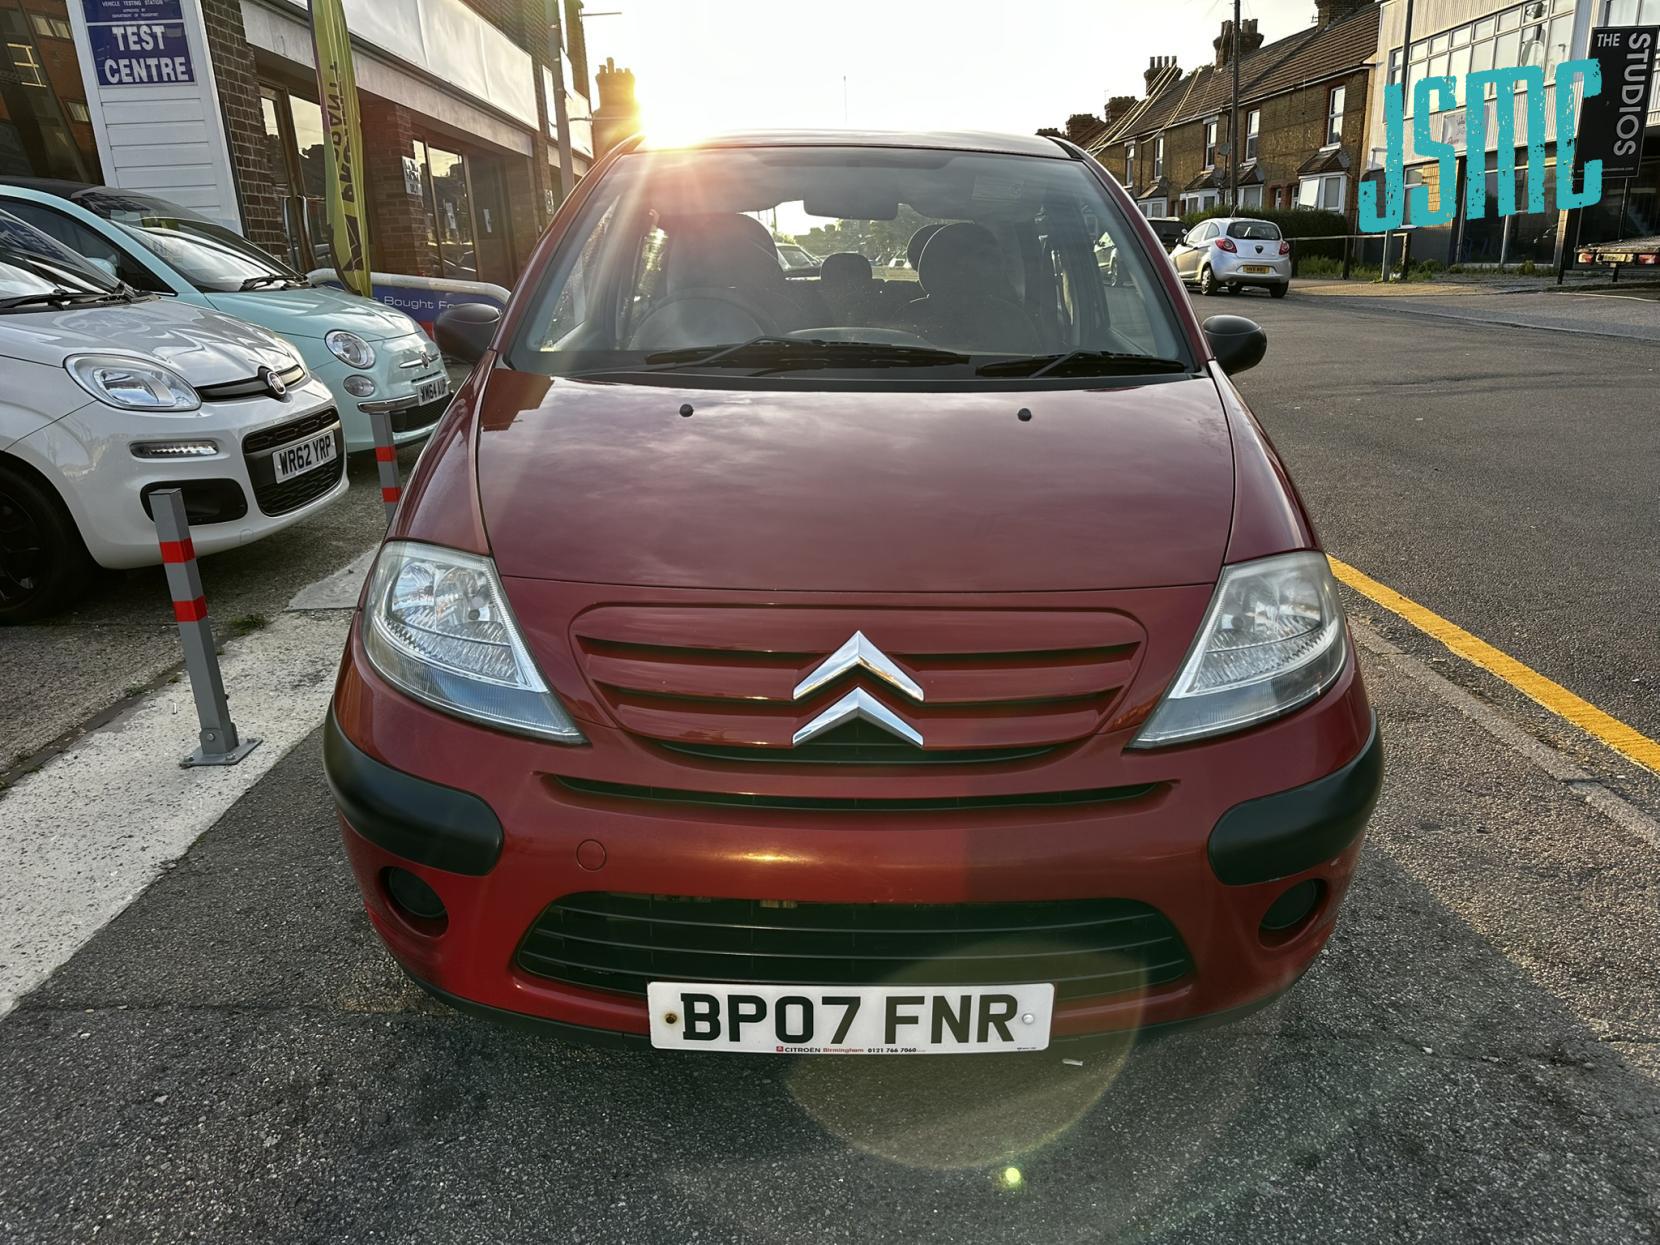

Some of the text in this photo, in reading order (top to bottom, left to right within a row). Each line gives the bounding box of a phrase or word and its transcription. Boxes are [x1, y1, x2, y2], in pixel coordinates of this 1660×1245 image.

[111, 25, 165, 51] TEST
[1597, 33, 1621, 47] THE
[104, 56, 190, 84] CENTRE
[1613, 32, 1652, 157] STUDIOS
[384, 295, 434, 310] Bought
[279, 435, 331, 476] WR62 YRP
[680, 992, 1018, 1044] BP07 FNR
